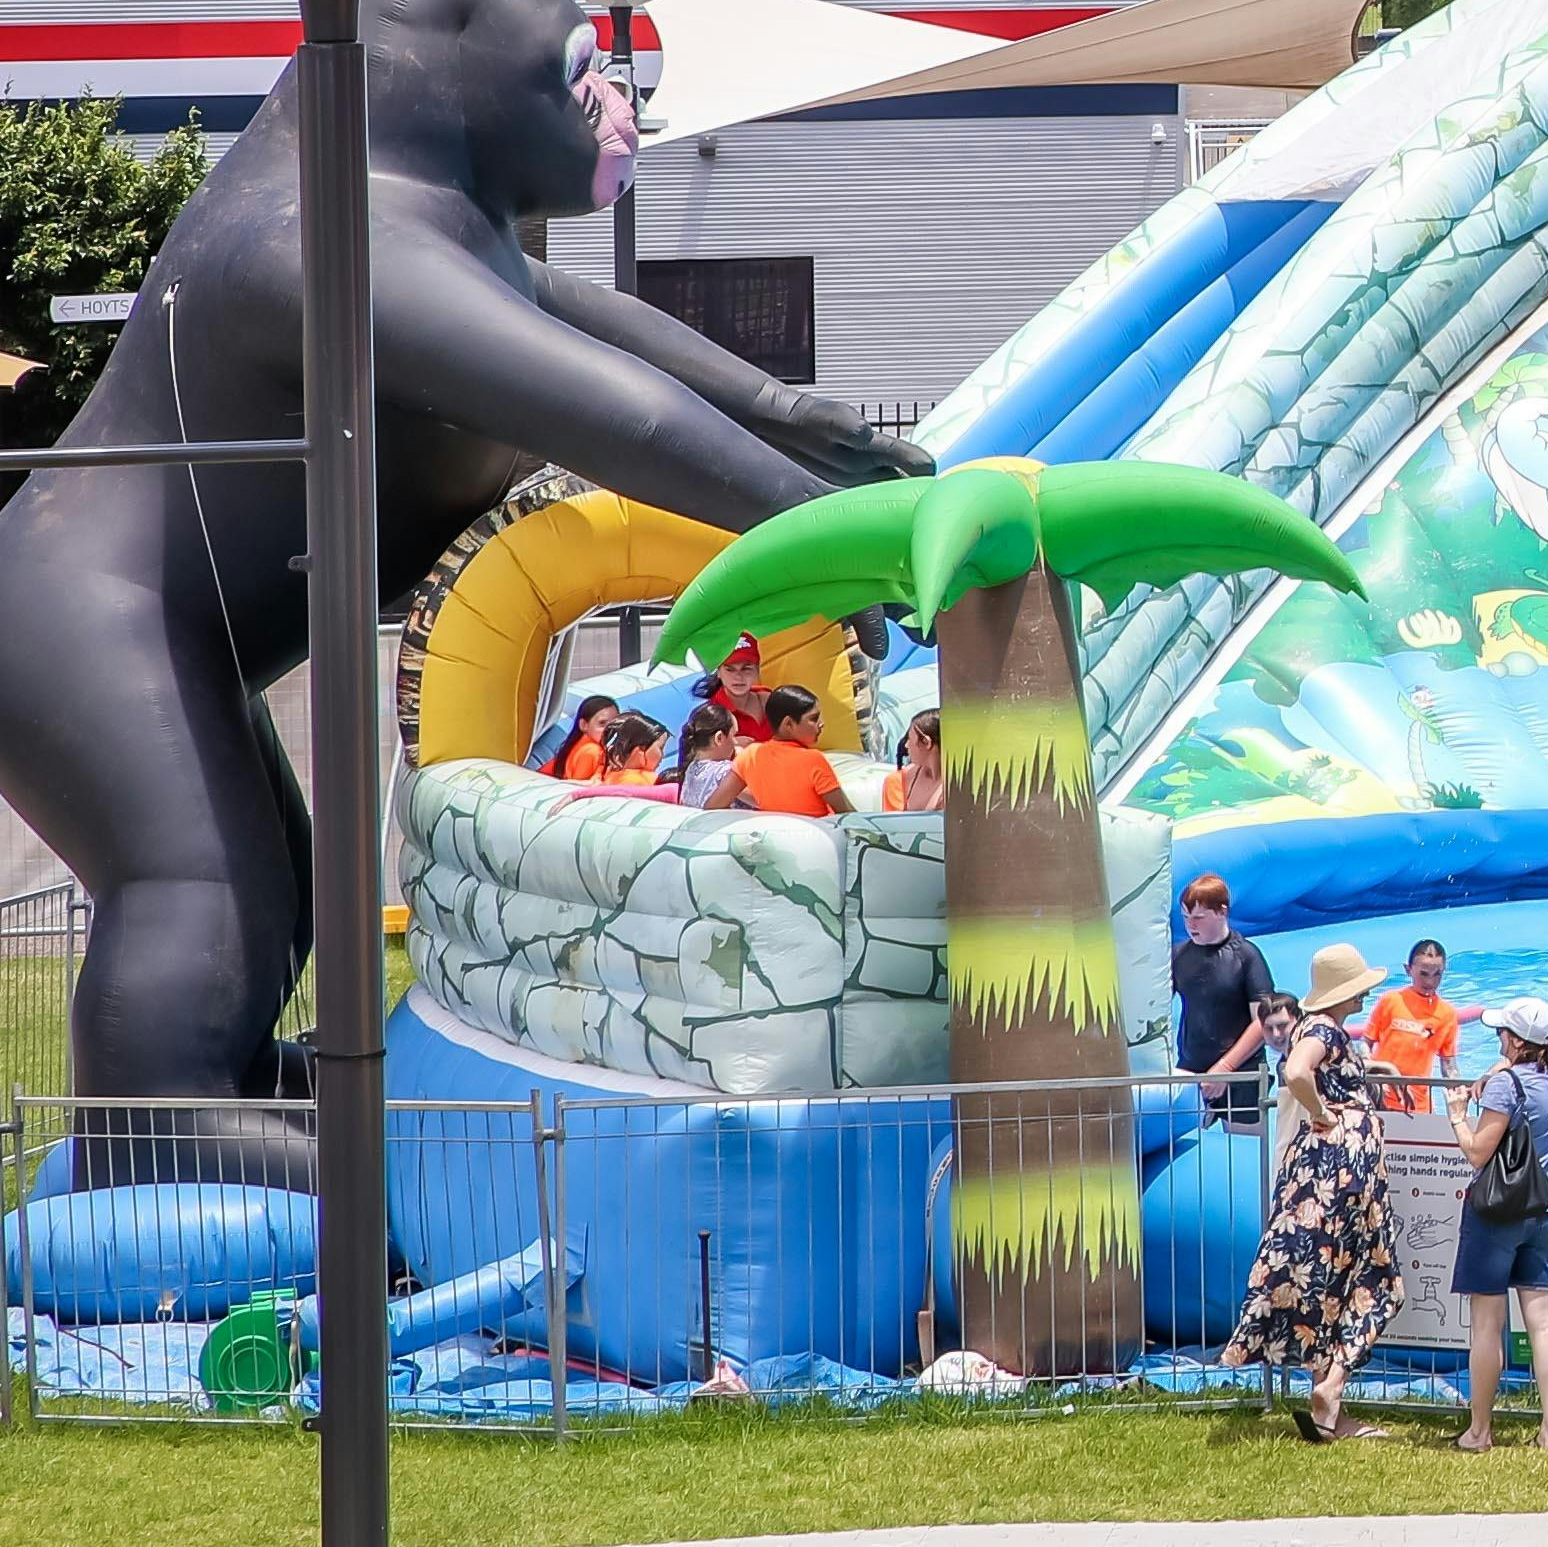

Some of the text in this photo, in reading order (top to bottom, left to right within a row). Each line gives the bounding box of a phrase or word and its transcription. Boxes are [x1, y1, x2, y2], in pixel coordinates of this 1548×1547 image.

[81, 299, 130, 315] HOYTS
[1409, 1153, 1439, 1164] simple
[1441, 1154, 1468, 1166] hygie
[1410, 1166, 1437, 1177] hands
[1440, 1168, 1472, 1179] regular
